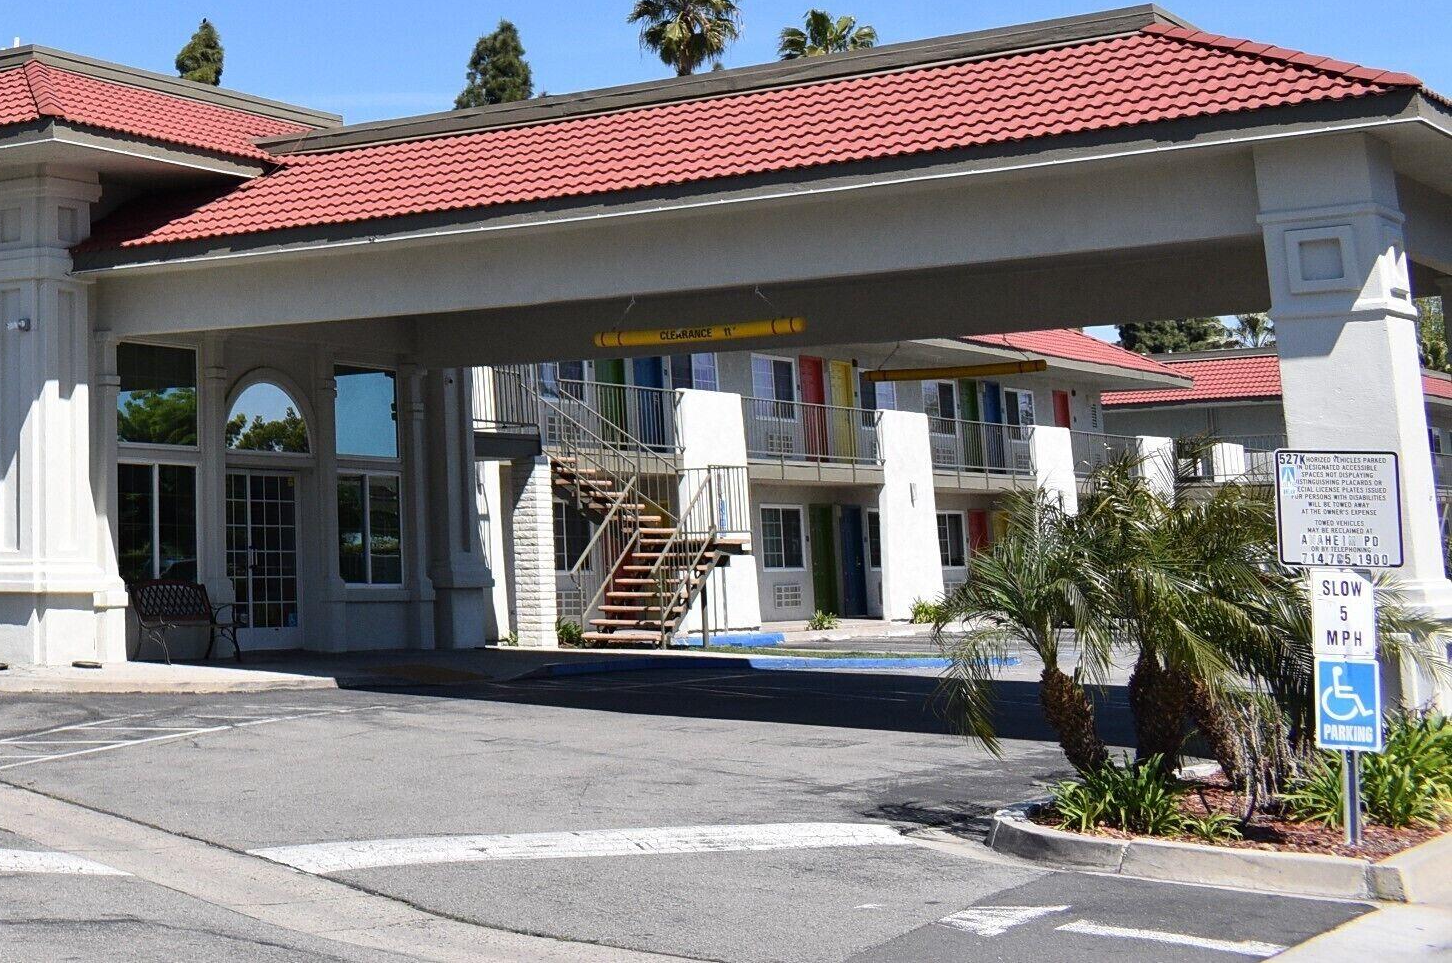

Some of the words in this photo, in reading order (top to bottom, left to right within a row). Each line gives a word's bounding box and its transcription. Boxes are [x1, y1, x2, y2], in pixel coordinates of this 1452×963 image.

[659, 327, 713, 341] CLEARANCE
[1279, 453, 1306, 464] 527K
[1333, 456, 1361, 464] VEHICLES
[1341, 464, 1377, 472] ACCESSIBLE
[1338, 471, 1374, 479] DISPLAYING
[1342, 486, 1364, 494] PLATES
[1323, 508, 1349, 516] OWNER'S
[1314, 519, 1335, 527] TOWED
[1364, 535, 1379, 547] PD
[1322, 579, 1363, 596] SLOW
[1339, 605, 1348, 621] 5
[1326, 629, 1363, 647] MPH
[1323, 723, 1374, 743] PARKING
